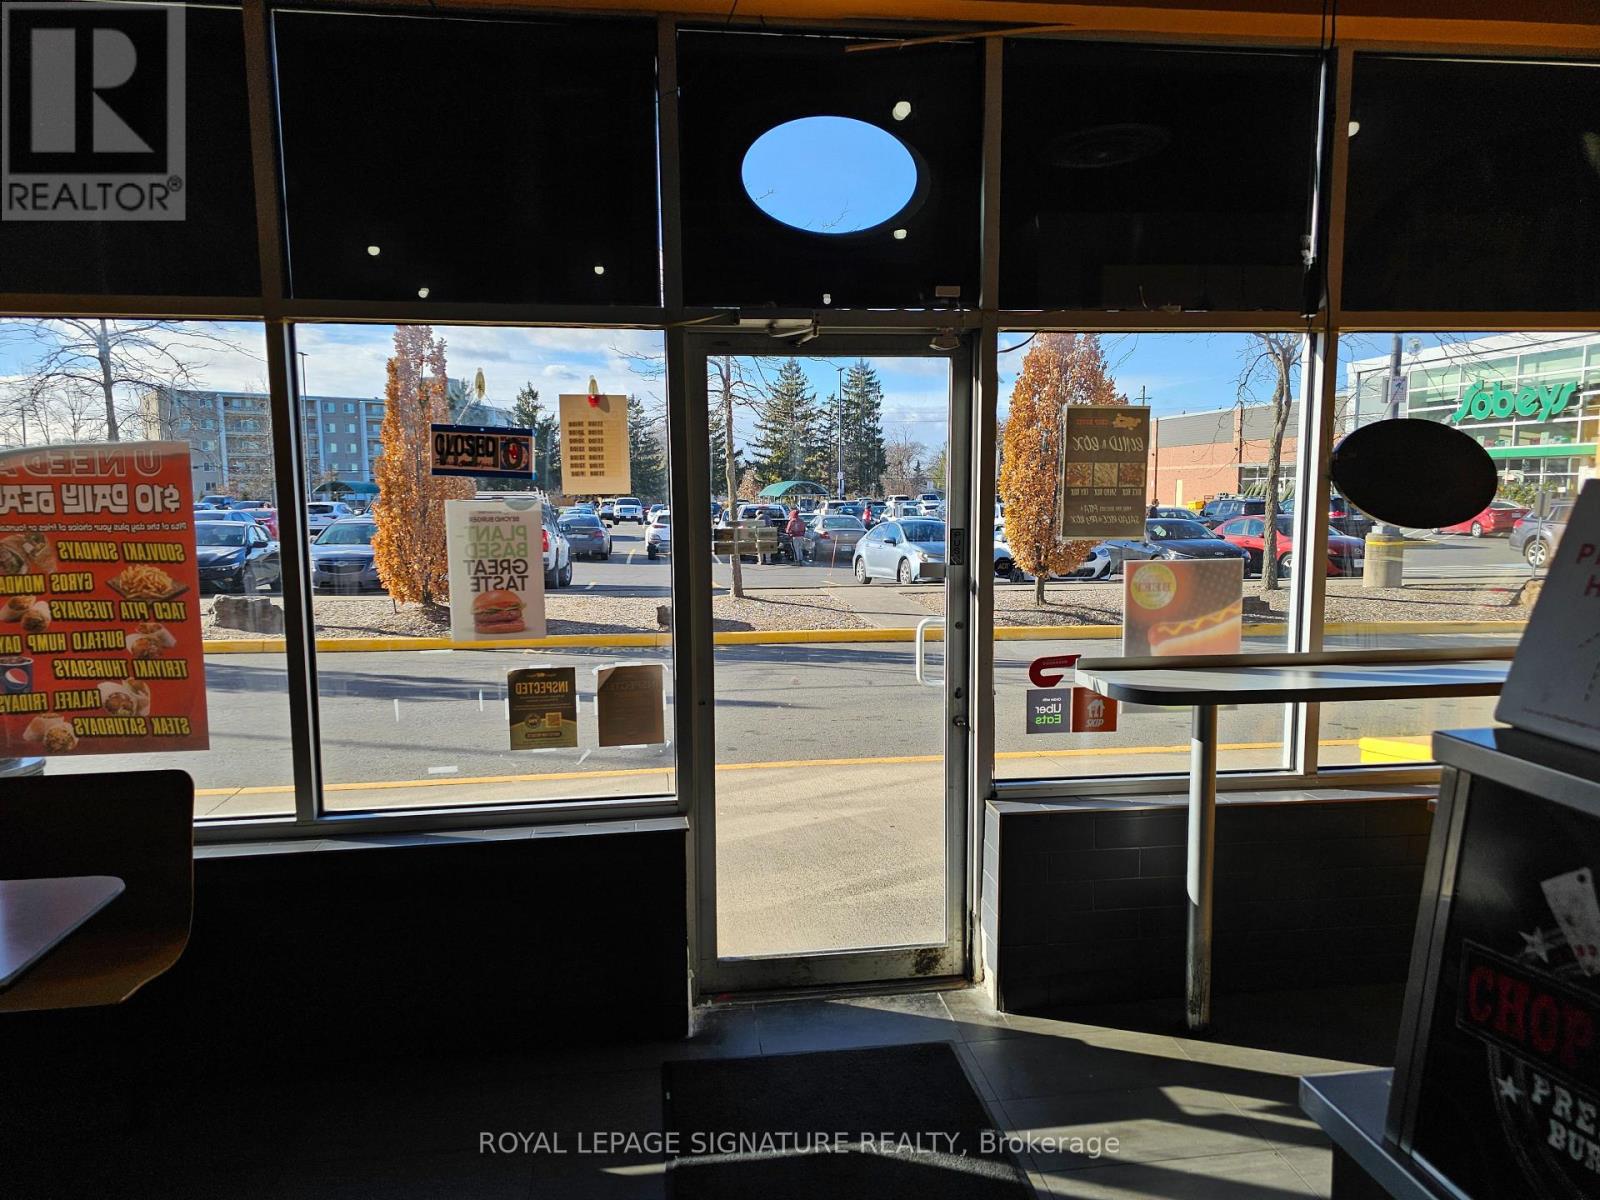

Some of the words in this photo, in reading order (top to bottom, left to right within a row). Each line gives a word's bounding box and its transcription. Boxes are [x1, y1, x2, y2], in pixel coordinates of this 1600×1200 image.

[1452, 378, 1578, 424] Sobeys
[435, 433, 496, 457] CLOSED
[1467, 965, 1594, 1070] CHOP
